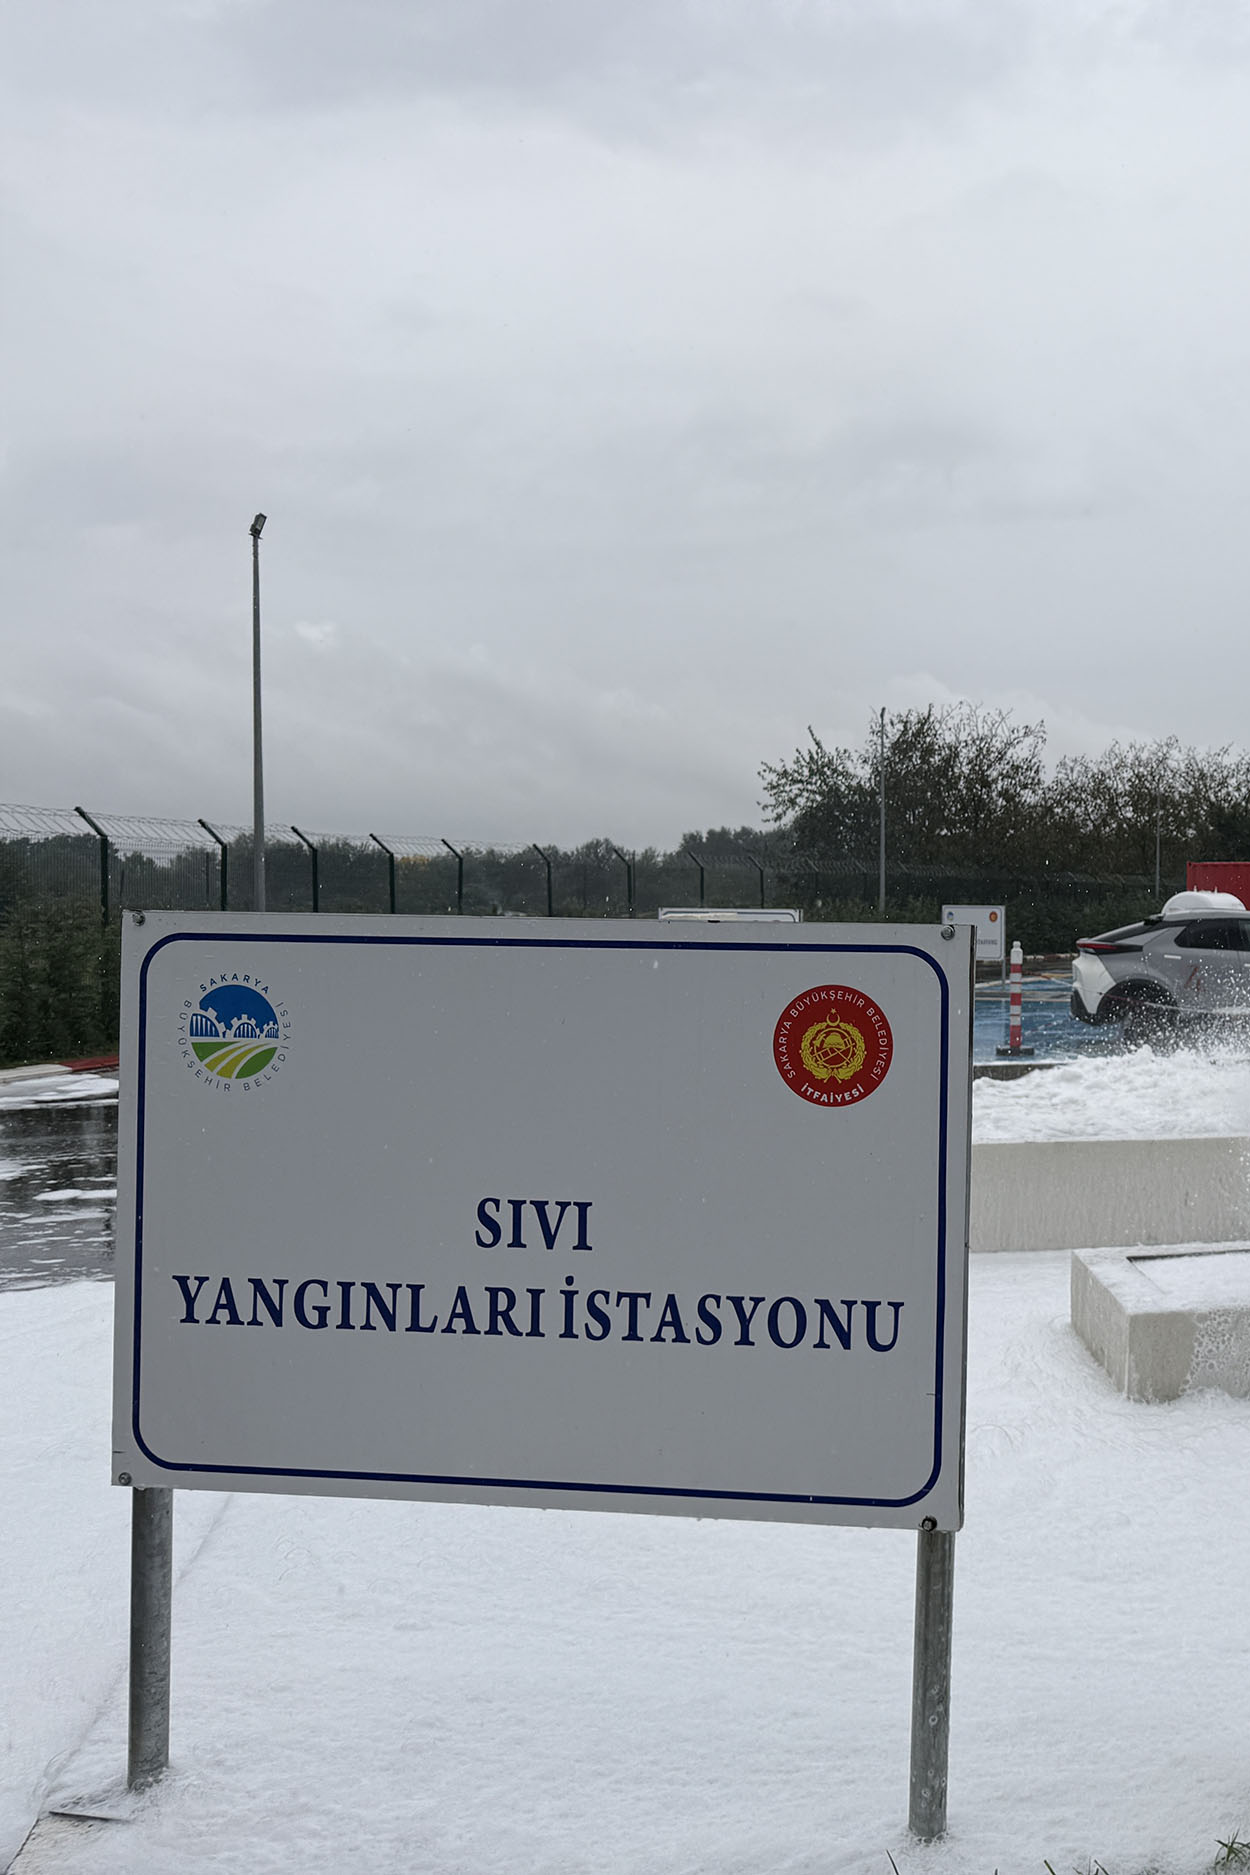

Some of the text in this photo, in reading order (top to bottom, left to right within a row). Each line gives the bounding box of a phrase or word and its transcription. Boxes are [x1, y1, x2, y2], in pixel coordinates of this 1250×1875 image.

[199, 972, 270, 994] SAKARYA
[778, 990, 890, 1081] SAKARYA BÜYÜKŞEHİR BELEDİYESİ
[800, 1082, 865, 1104] İTFAİYESİ
[475, 1197, 593, 1251] SIVI
[171, 1274, 905, 1353] YANGINLARI İSTASYONU
